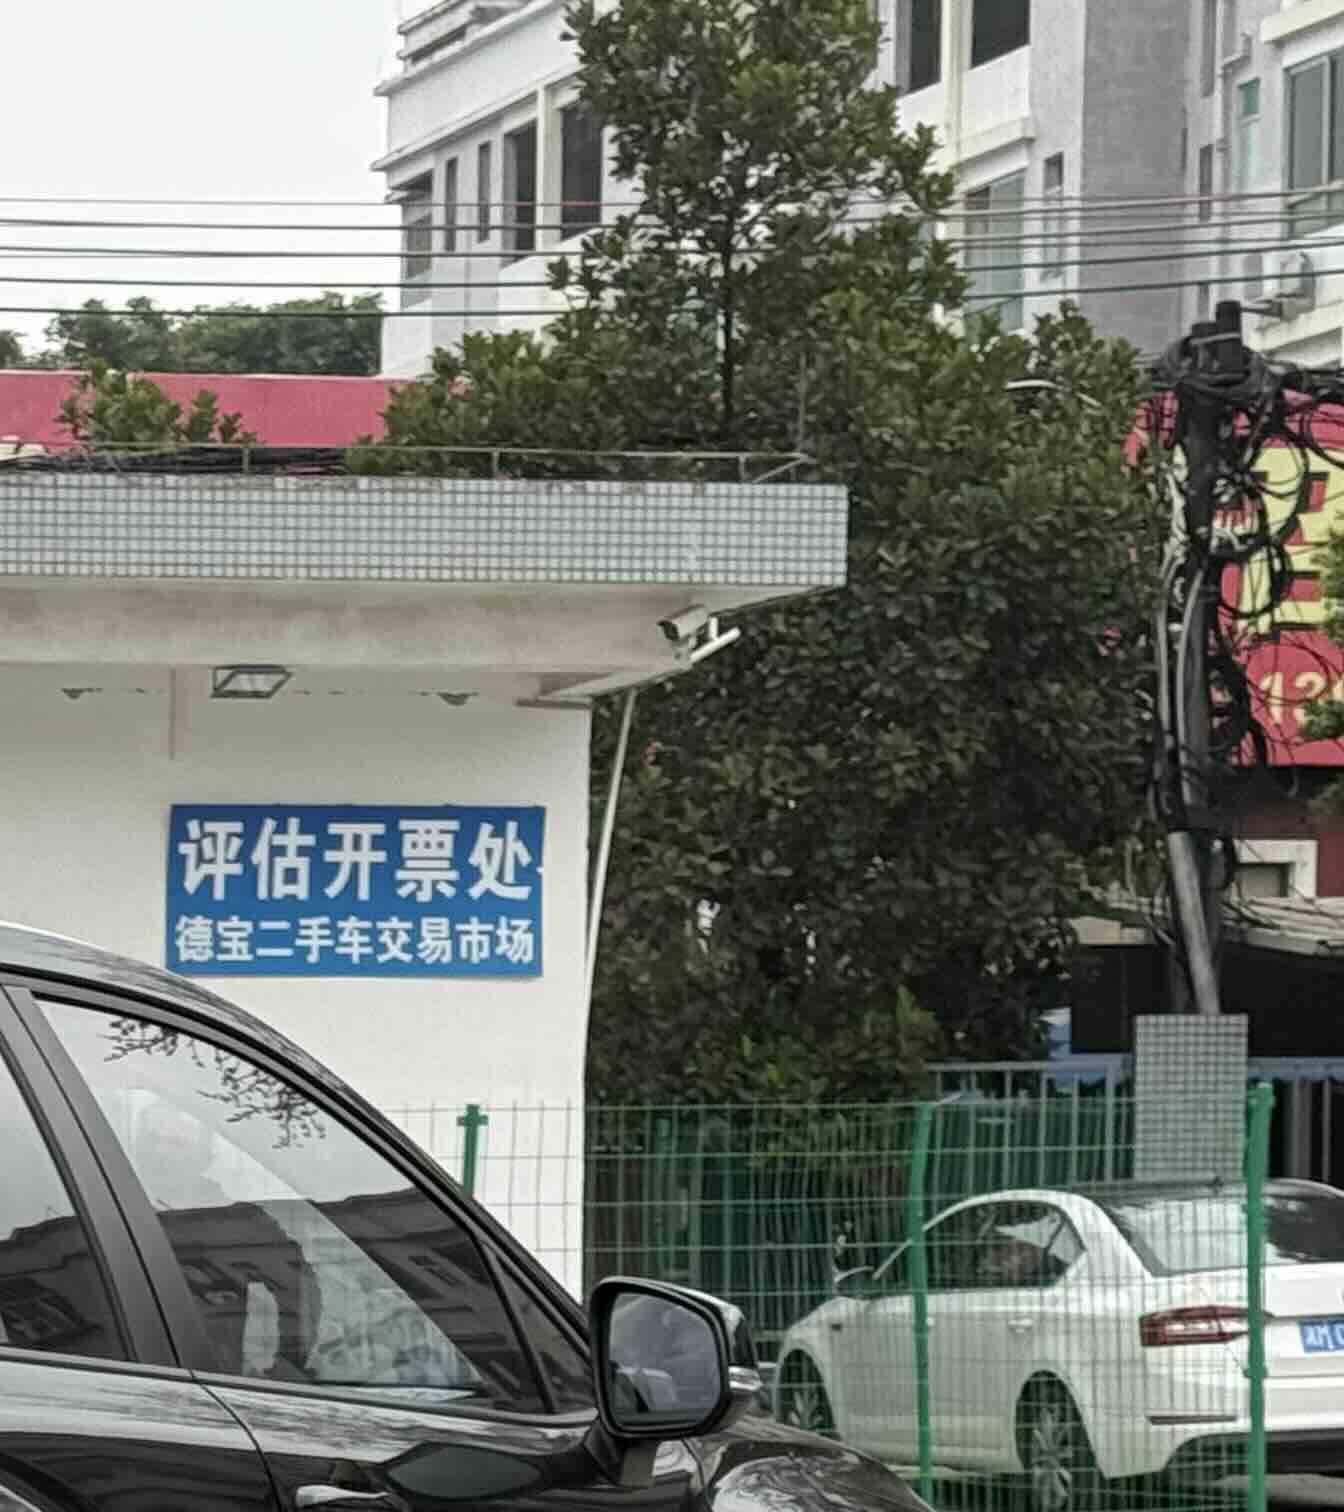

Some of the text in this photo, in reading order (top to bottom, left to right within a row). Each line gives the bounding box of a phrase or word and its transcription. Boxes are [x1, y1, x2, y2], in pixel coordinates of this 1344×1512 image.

[178, 816, 533, 902] 评估开票处
[175, 914, 535, 965] 德宝二手车交易市场
